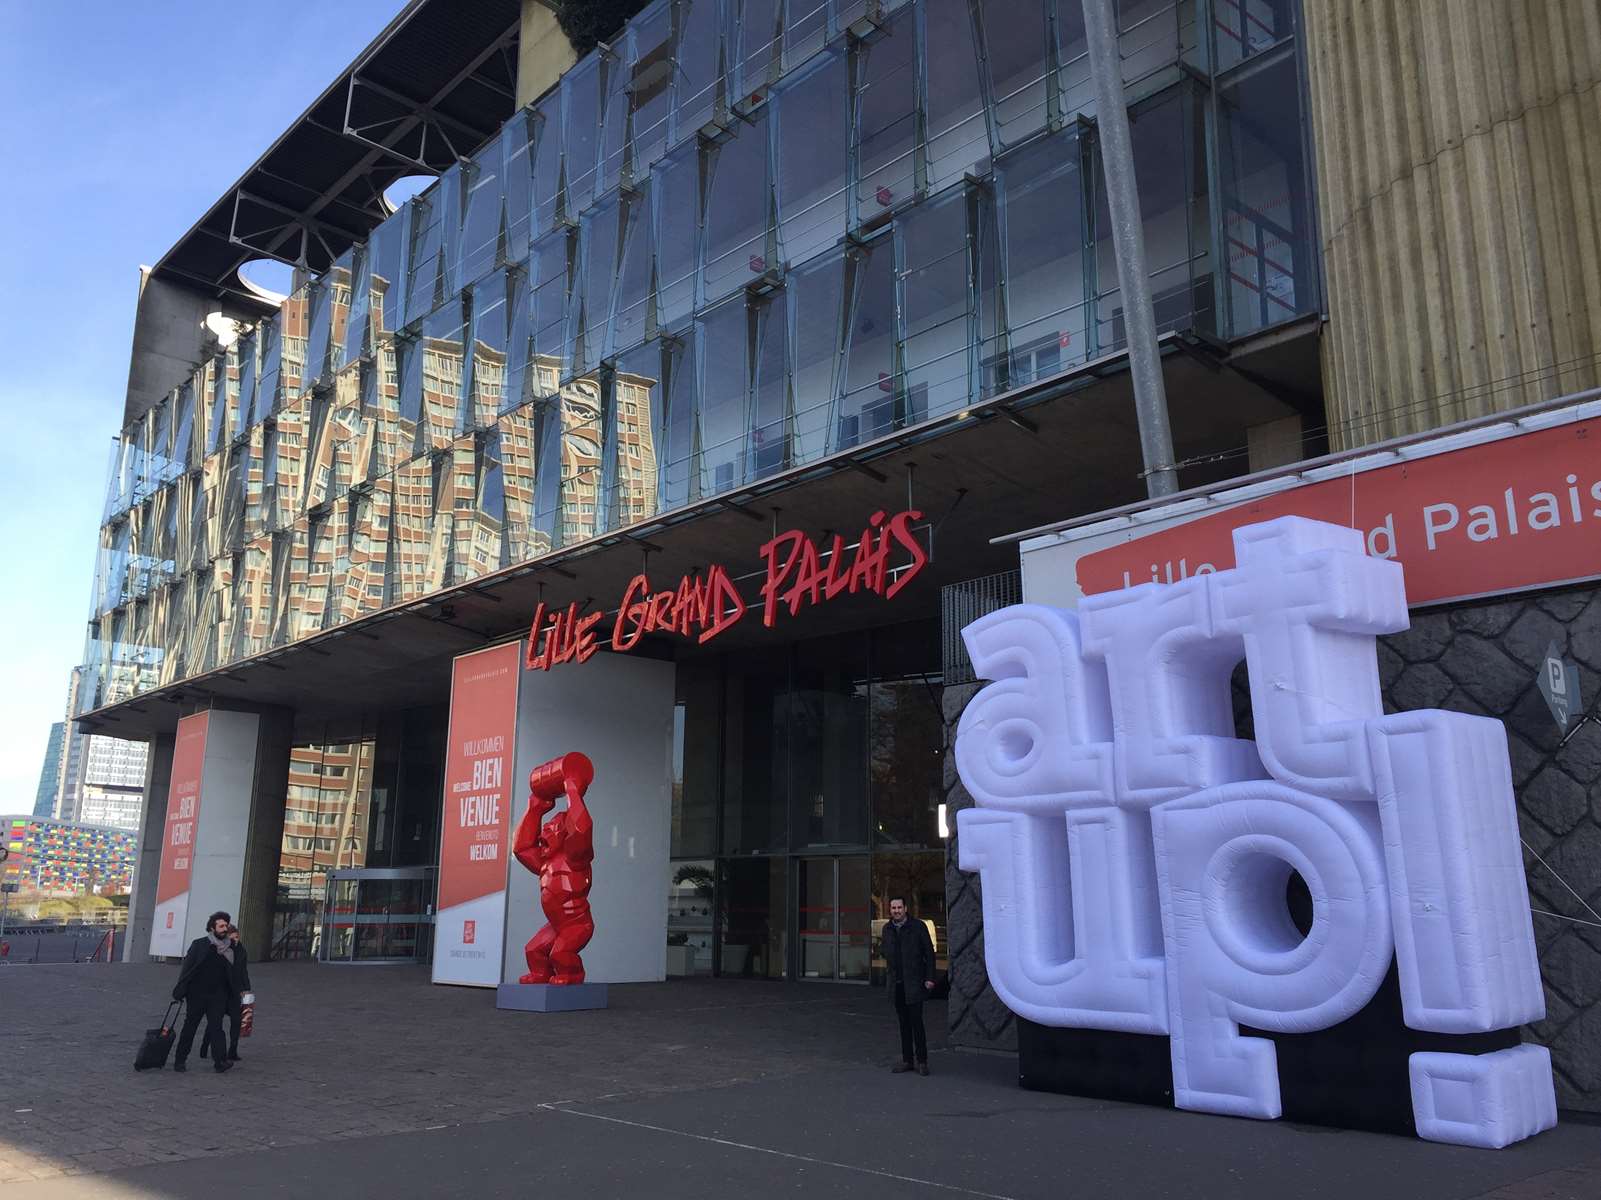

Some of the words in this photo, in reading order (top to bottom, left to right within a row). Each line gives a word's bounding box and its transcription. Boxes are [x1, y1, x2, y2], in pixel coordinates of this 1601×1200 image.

[955, 516, 1410, 809] art
[473, 757, 503, 791] BIEN
[460, 793, 501, 827] VENUE
